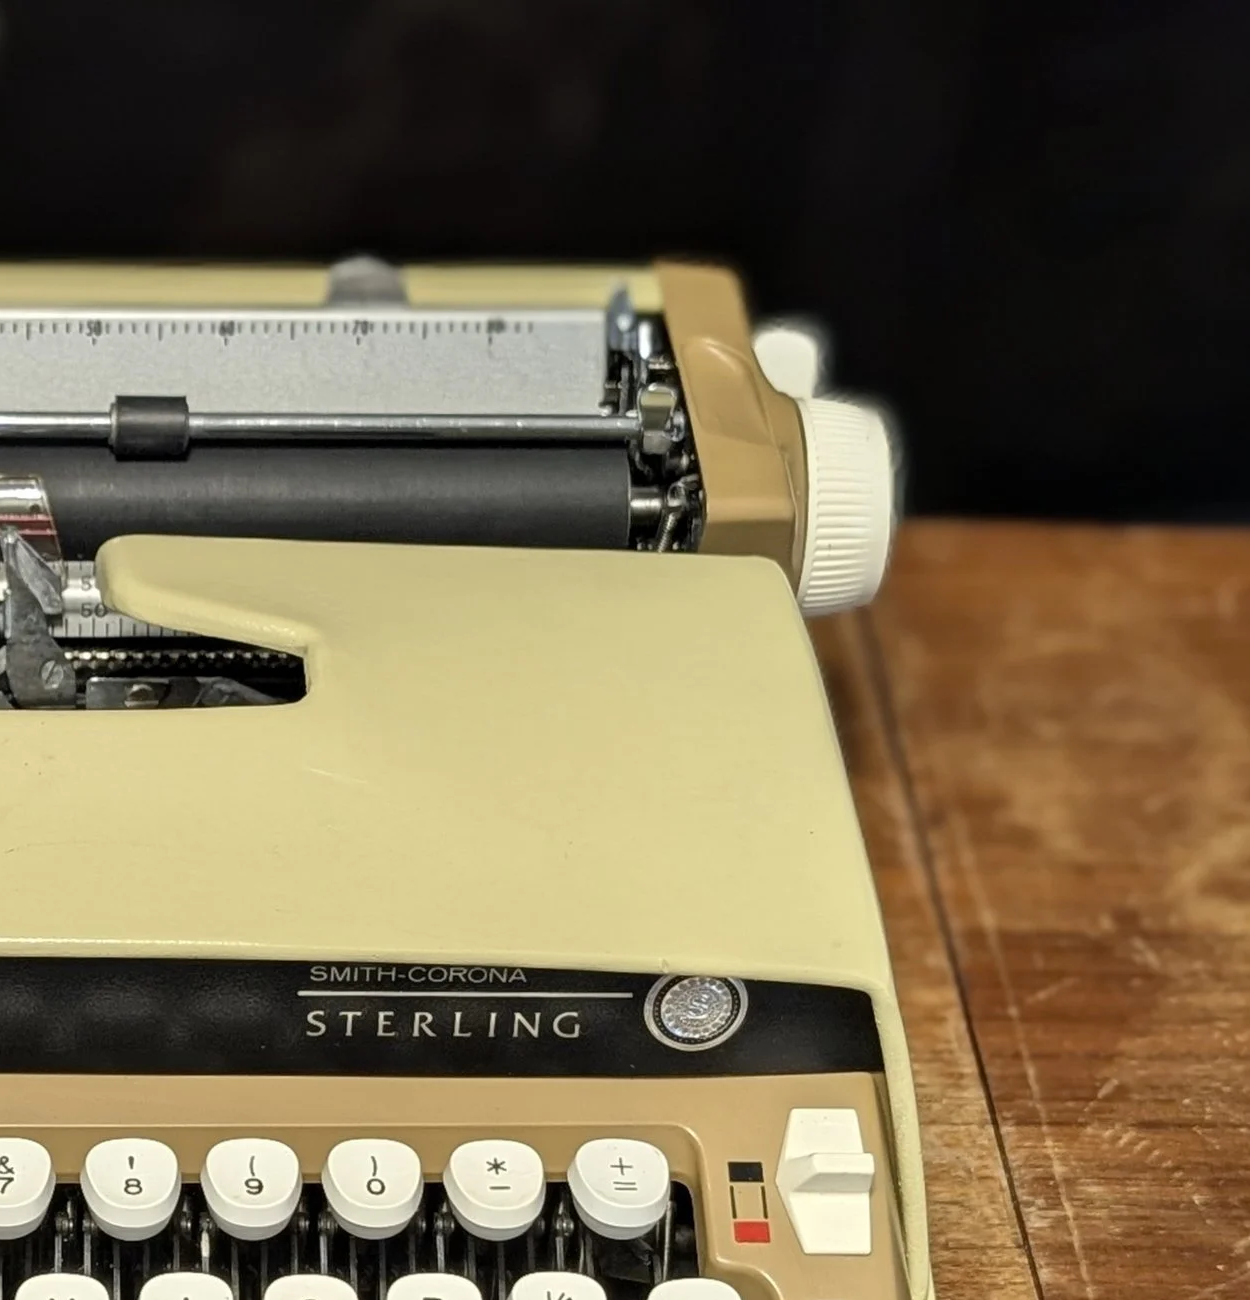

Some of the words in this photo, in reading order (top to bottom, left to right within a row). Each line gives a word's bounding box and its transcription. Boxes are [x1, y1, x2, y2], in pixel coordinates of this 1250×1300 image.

[80, 602, 107, 618] 50
[309, 965, 528, 983] SMITH-CORONA
[306, 1010, 580, 1038] STERLING
[249, 1155, 256, 1177] (
[370, 1155, 378, 1177] )
[609, 1157, 633, 1176] +
[123, 1178, 143, 1196] 8
[244, 1177, 264, 1196] 9
